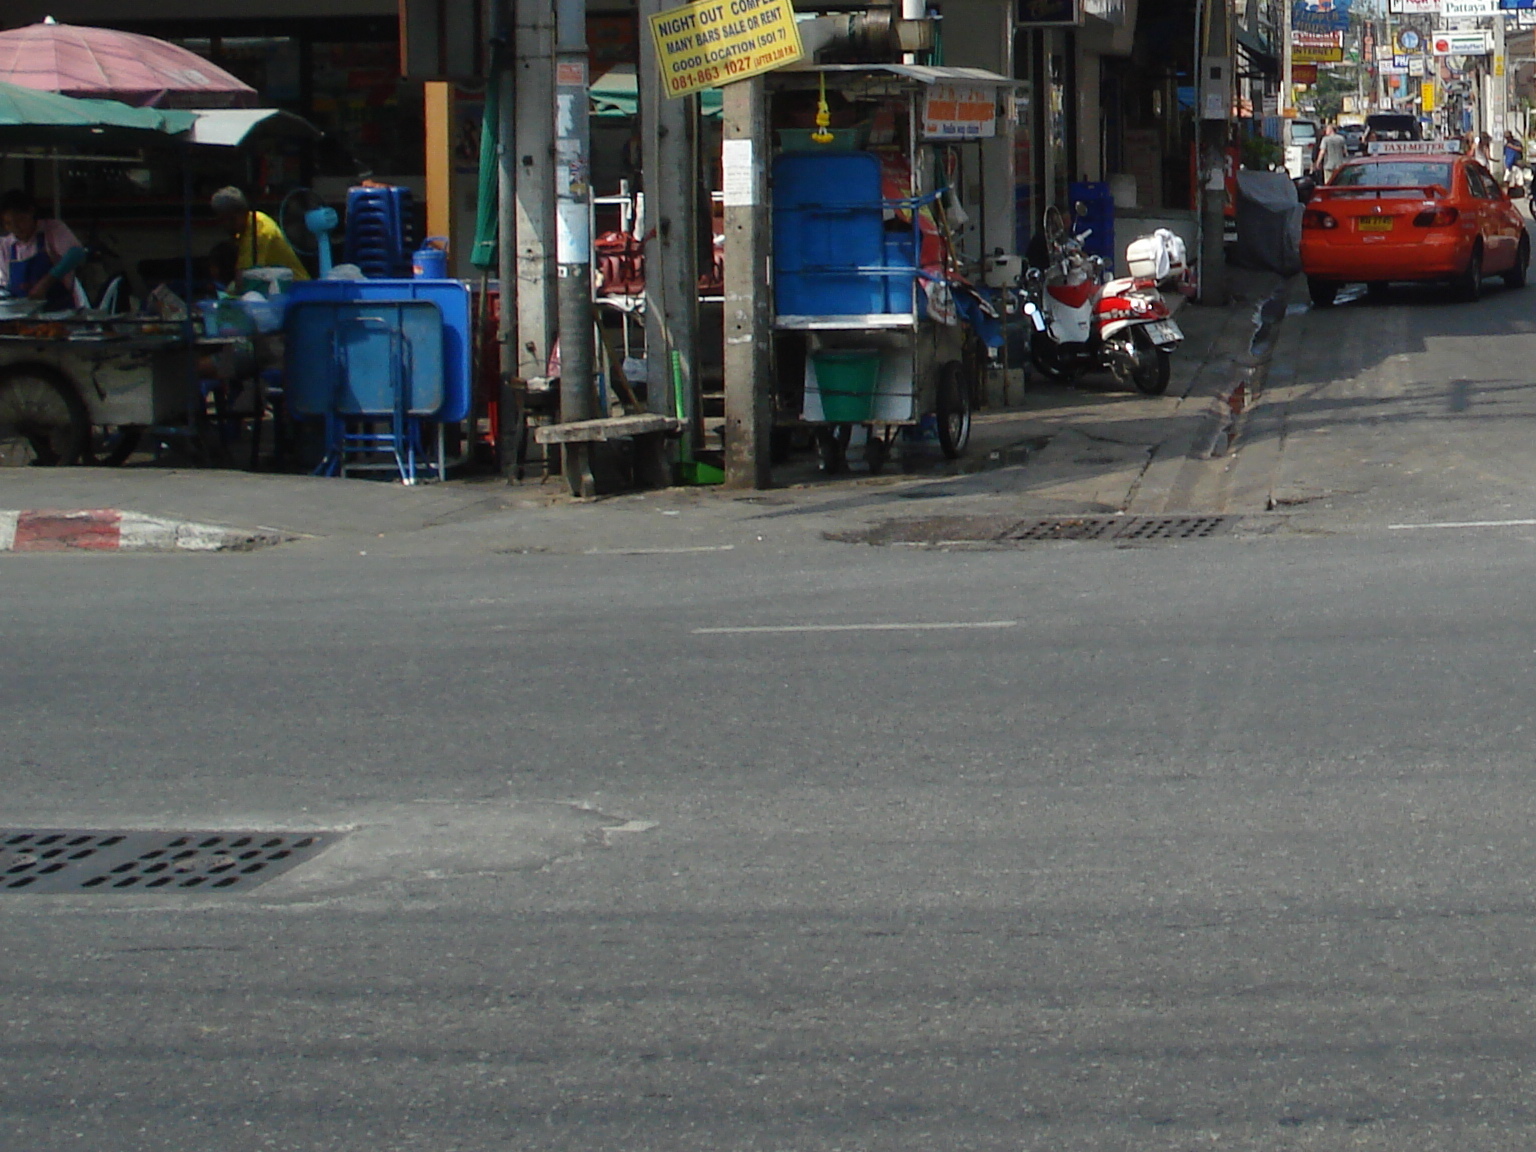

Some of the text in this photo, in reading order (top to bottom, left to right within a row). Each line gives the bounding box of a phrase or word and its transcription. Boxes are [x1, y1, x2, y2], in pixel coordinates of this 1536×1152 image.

[658, 14, 697, 38] NIGHT
[699, 5, 724, 25] OUT
[1446, 2, 1486, 14] Pattaya
[665, 6, 783, 55] MANY BARS SALE OR RENT
[1451, 43, 1484, 51] FamilyMart
[672, 27, 787, 73] GOOD LOCATION (SOI 7)
[671, 65, 721, 92] 081-863
[723, 56, 752, 77] 1027
[753, 51, 774, 69] (AFTER
